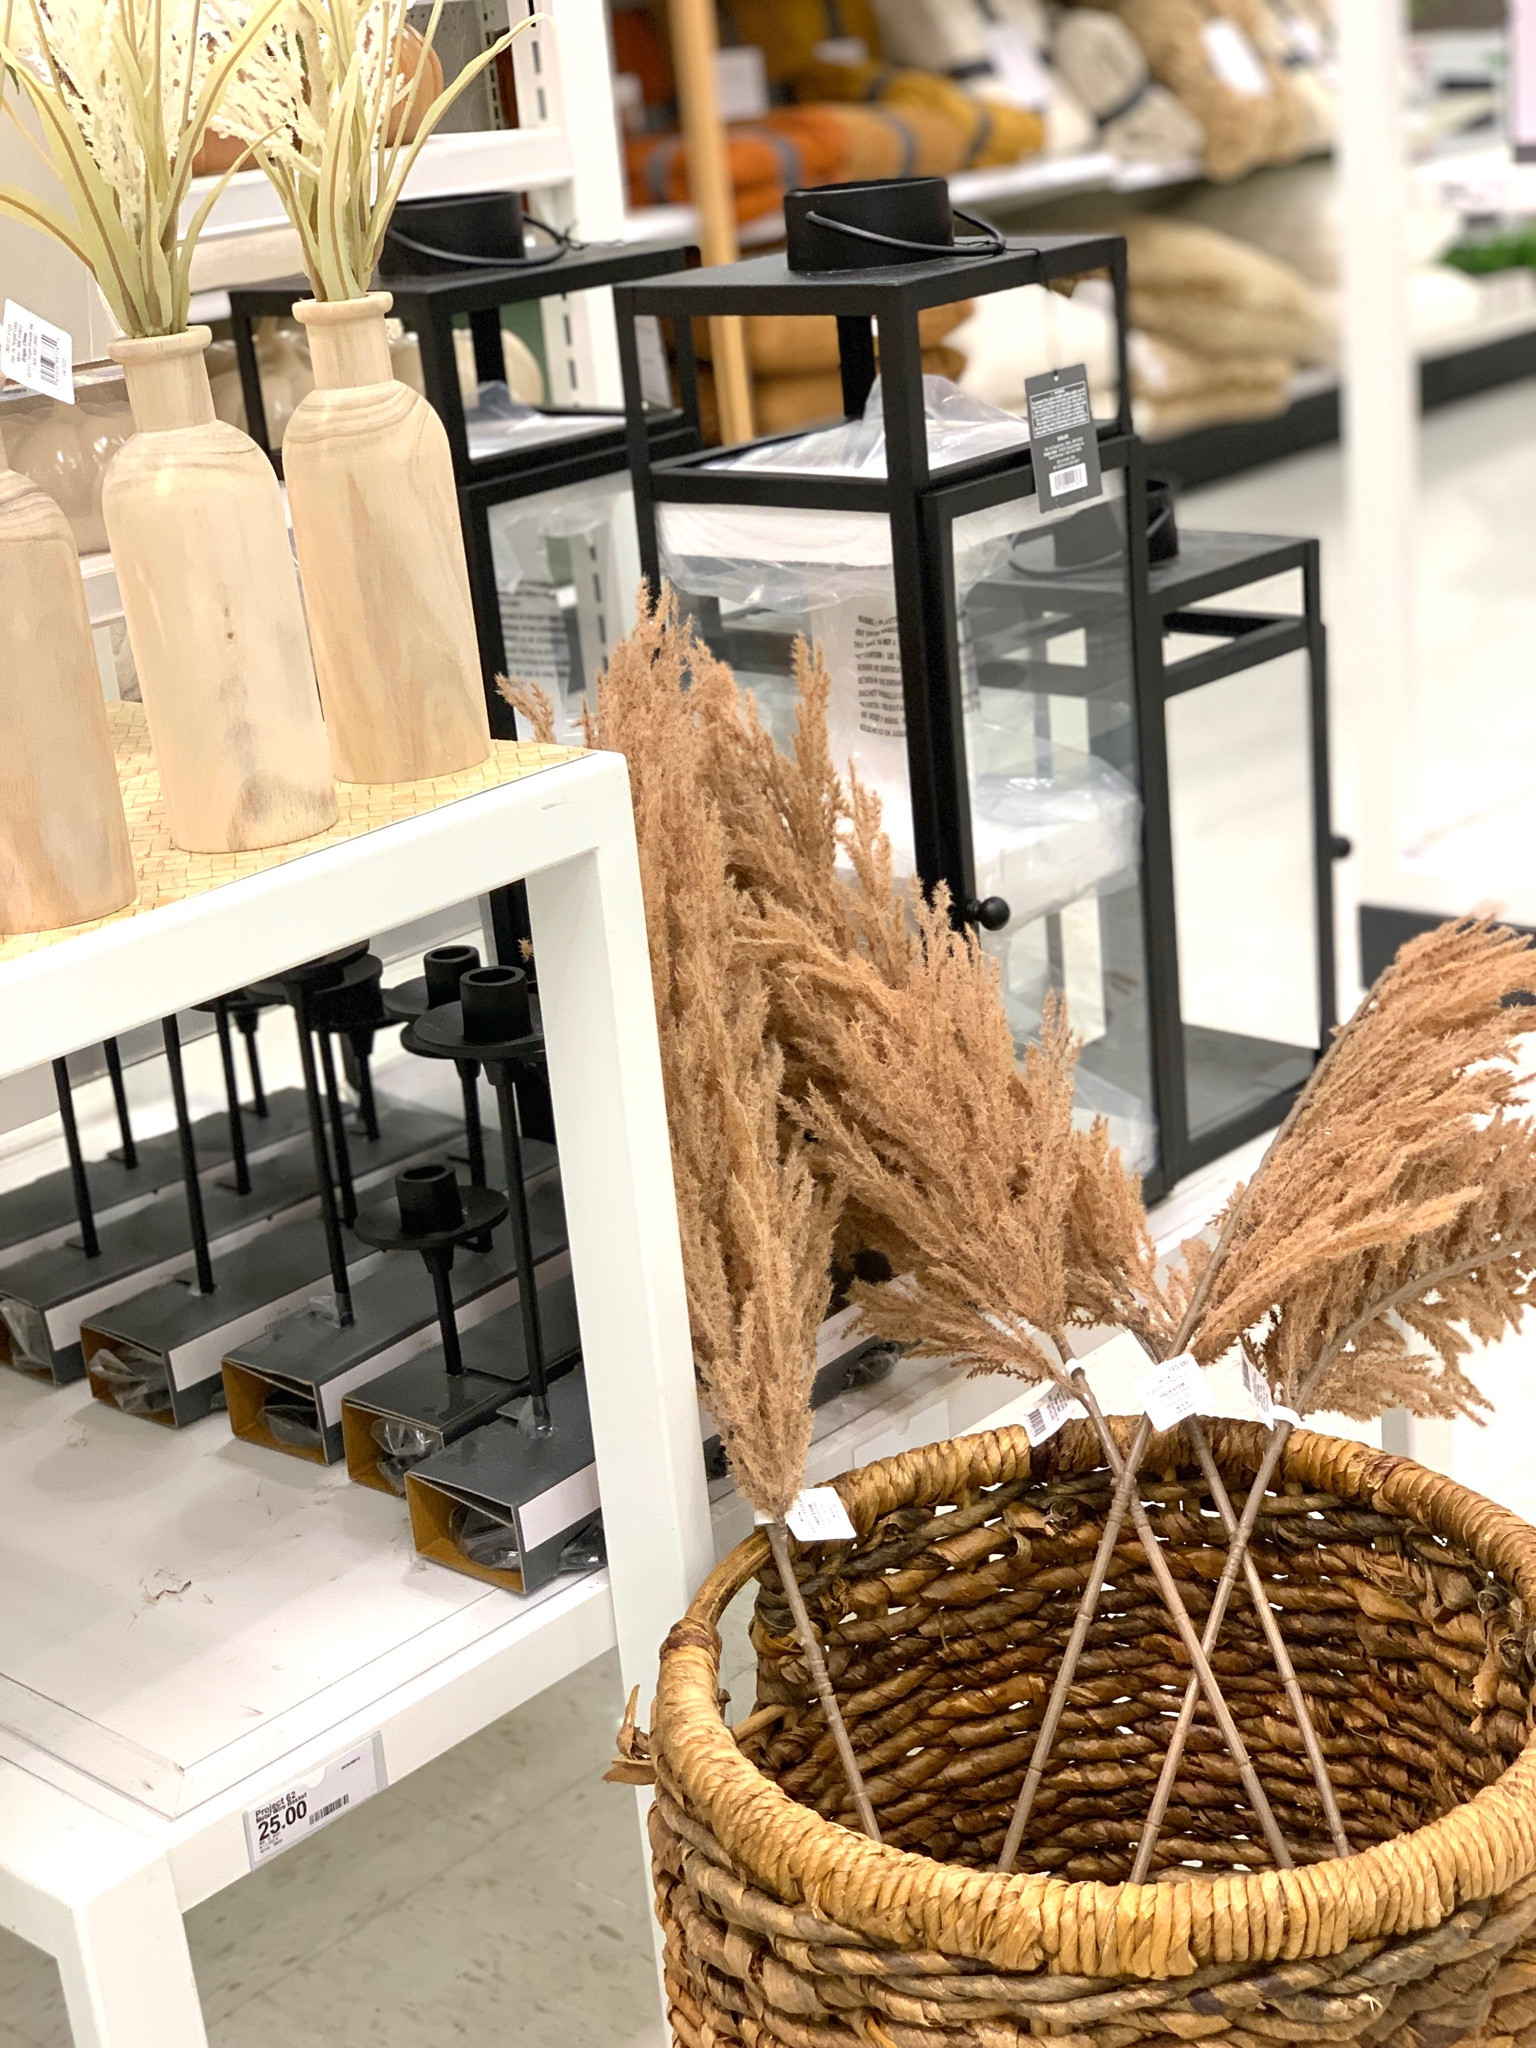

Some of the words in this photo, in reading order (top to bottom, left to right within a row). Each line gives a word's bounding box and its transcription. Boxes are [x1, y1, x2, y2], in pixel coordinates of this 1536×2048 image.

[255, 1797, 284, 1817] Project
[286, 1790, 296, 1802] 62
[258, 1800, 307, 1841] 25.00
